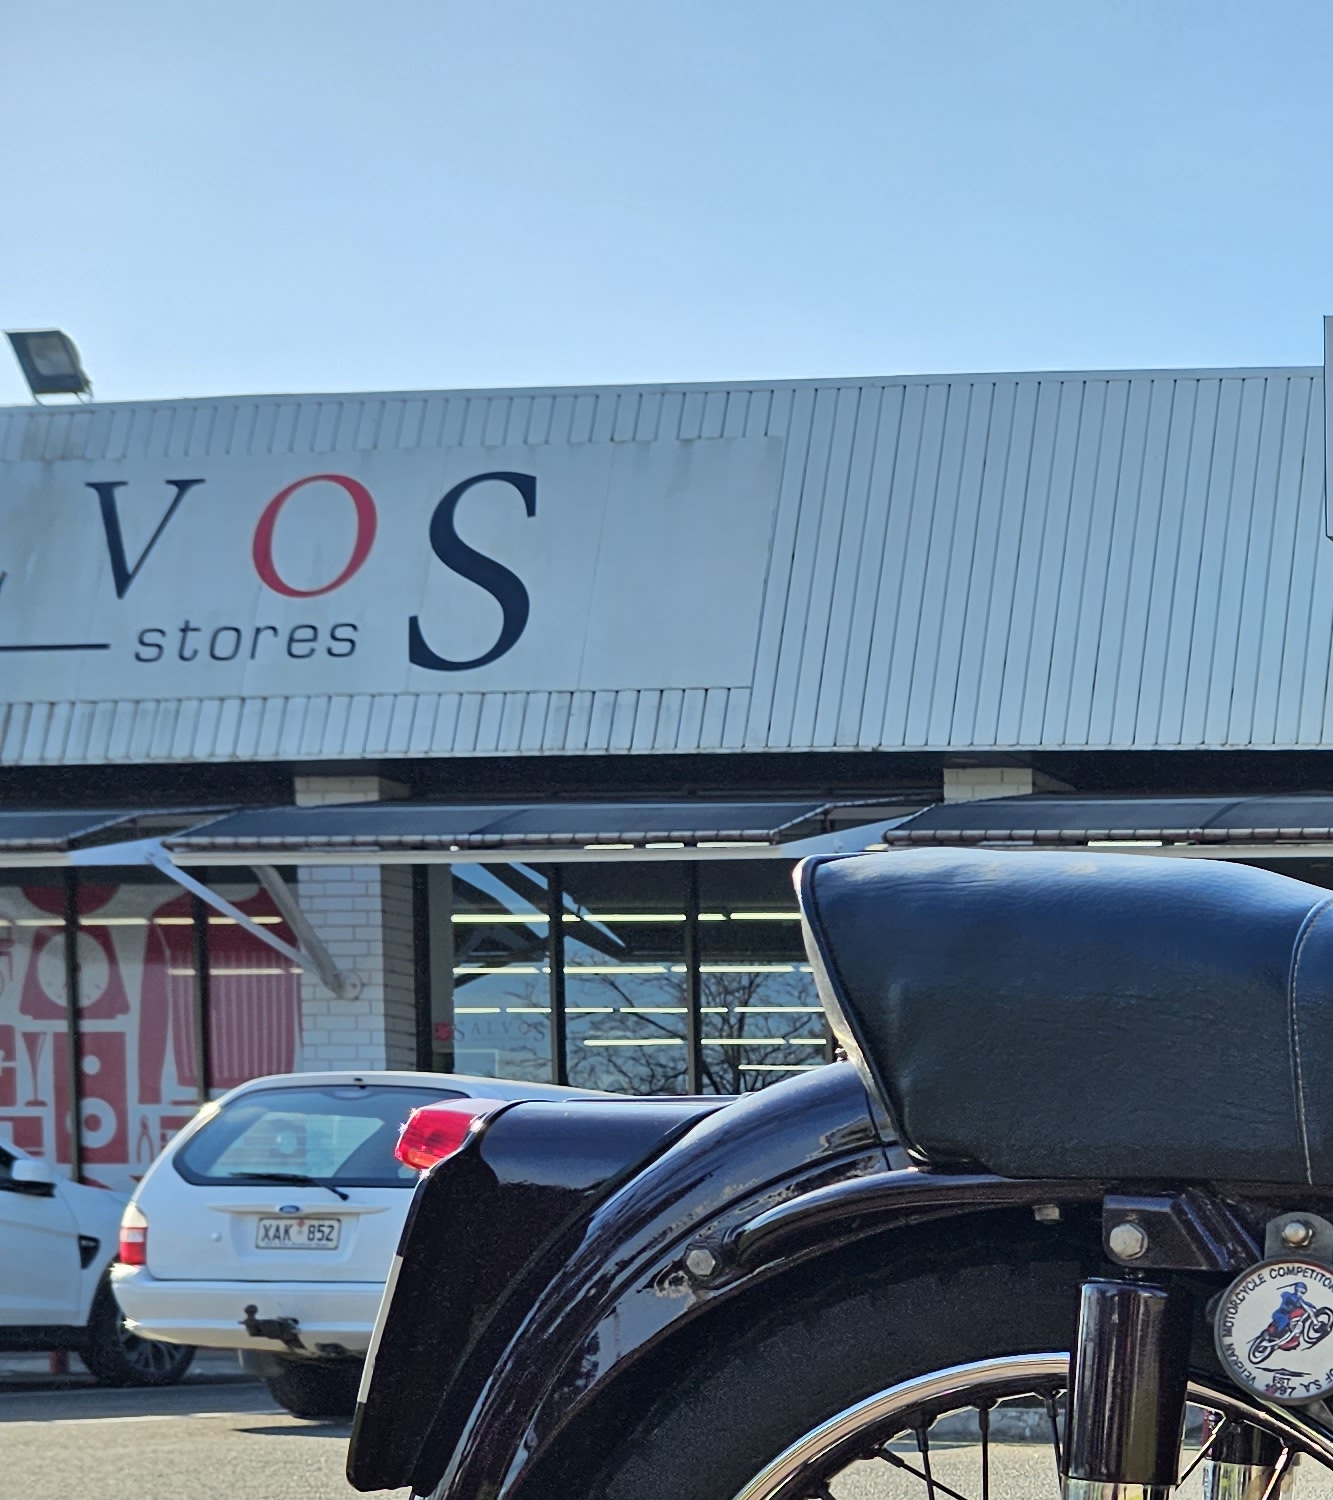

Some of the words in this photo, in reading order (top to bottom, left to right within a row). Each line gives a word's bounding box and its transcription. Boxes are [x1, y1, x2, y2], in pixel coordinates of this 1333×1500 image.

[0, 471, 538, 672] VOS
[133, 617, 359, 664] stores
[453, 1019, 547, 1043] SALVOS
[261, 1224, 294, 1242] XAK
[307, 1224, 335, 1242] 852
[1222, 1273, 1267, 1337] MOTORCYCLE
